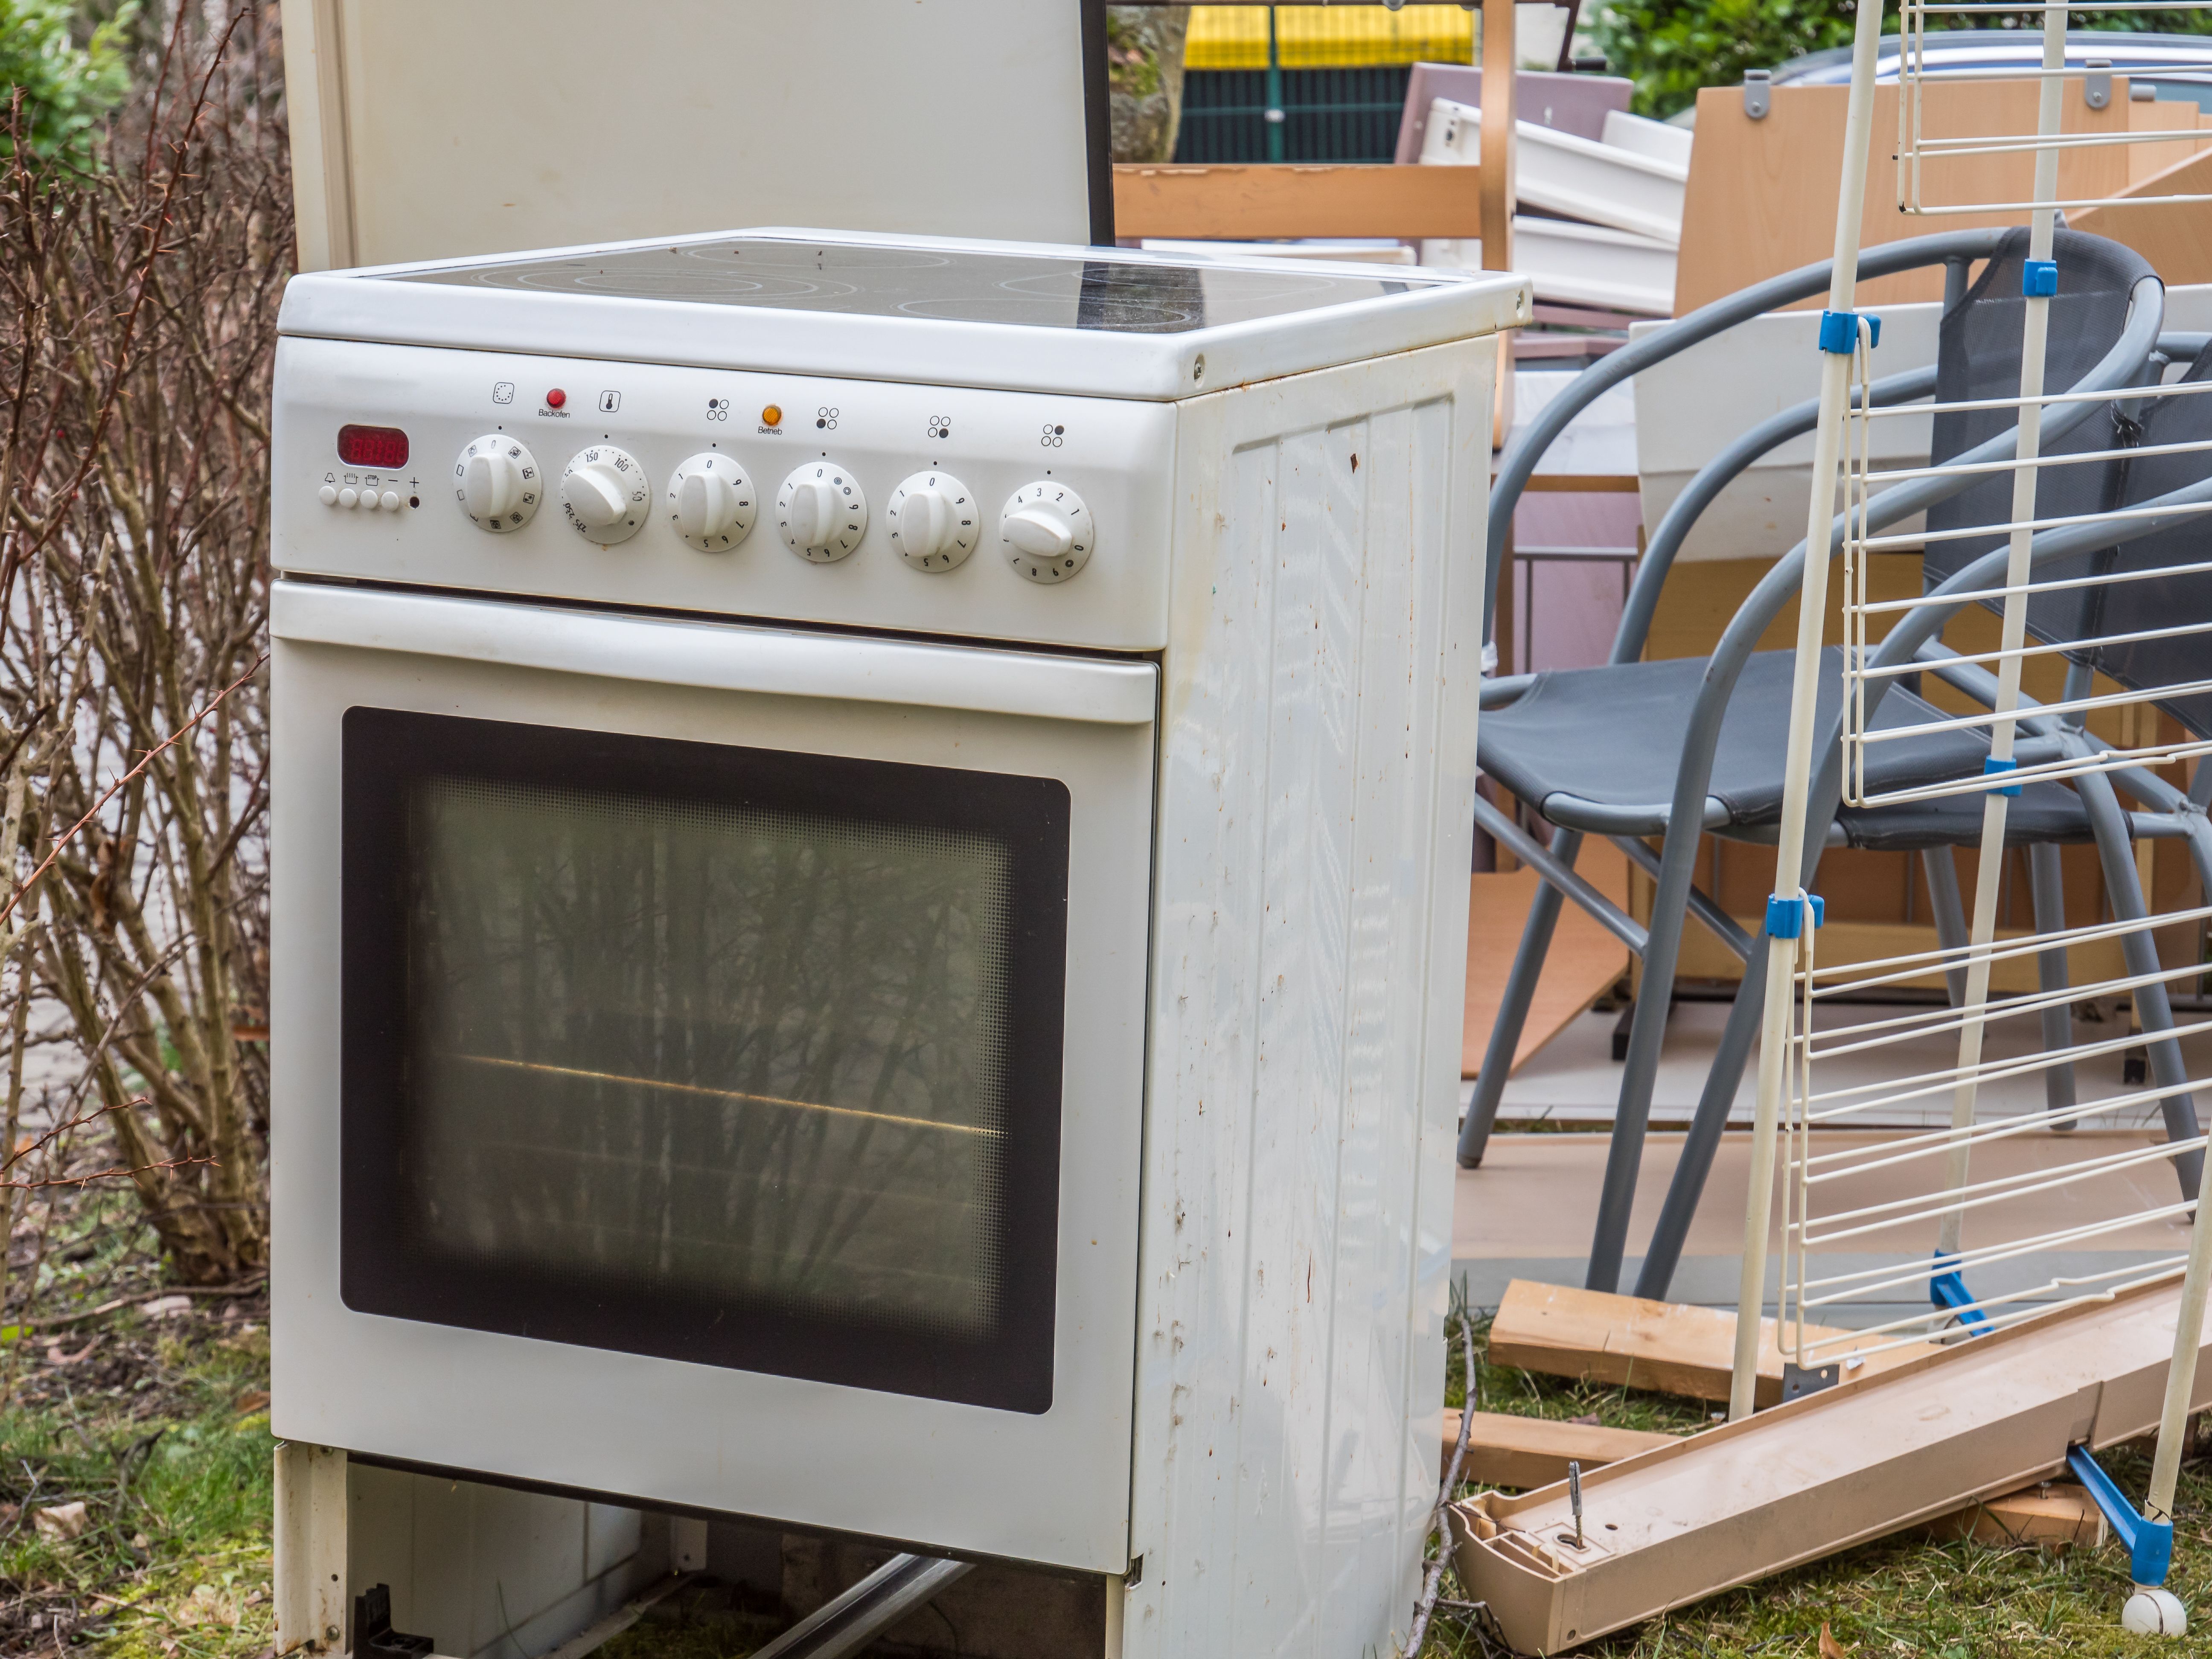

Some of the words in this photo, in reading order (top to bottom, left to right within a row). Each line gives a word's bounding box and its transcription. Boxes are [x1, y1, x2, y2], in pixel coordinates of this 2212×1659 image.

[538, 409, 570, 418] Backofen
[758, 426, 782, 435] Betrieb
[491, 440, 496, 449] 0
[586, 452, 598, 463] 150
[614, 457, 629, 472] 100
[707, 460, 712, 468] 0
[817, 469, 823, 477] 0
[929, 477, 935, 486] 0
[632, 491, 643, 501] 50
[1037, 488, 1042, 497] 3
[1056, 492, 1063, 501] 2
[1018, 495, 1023, 504] 4
[704, 539, 708, 547] 5
[807, 548, 811, 556] 5
[924, 558, 928, 567] 5
[1032, 568, 1037, 576] 8
